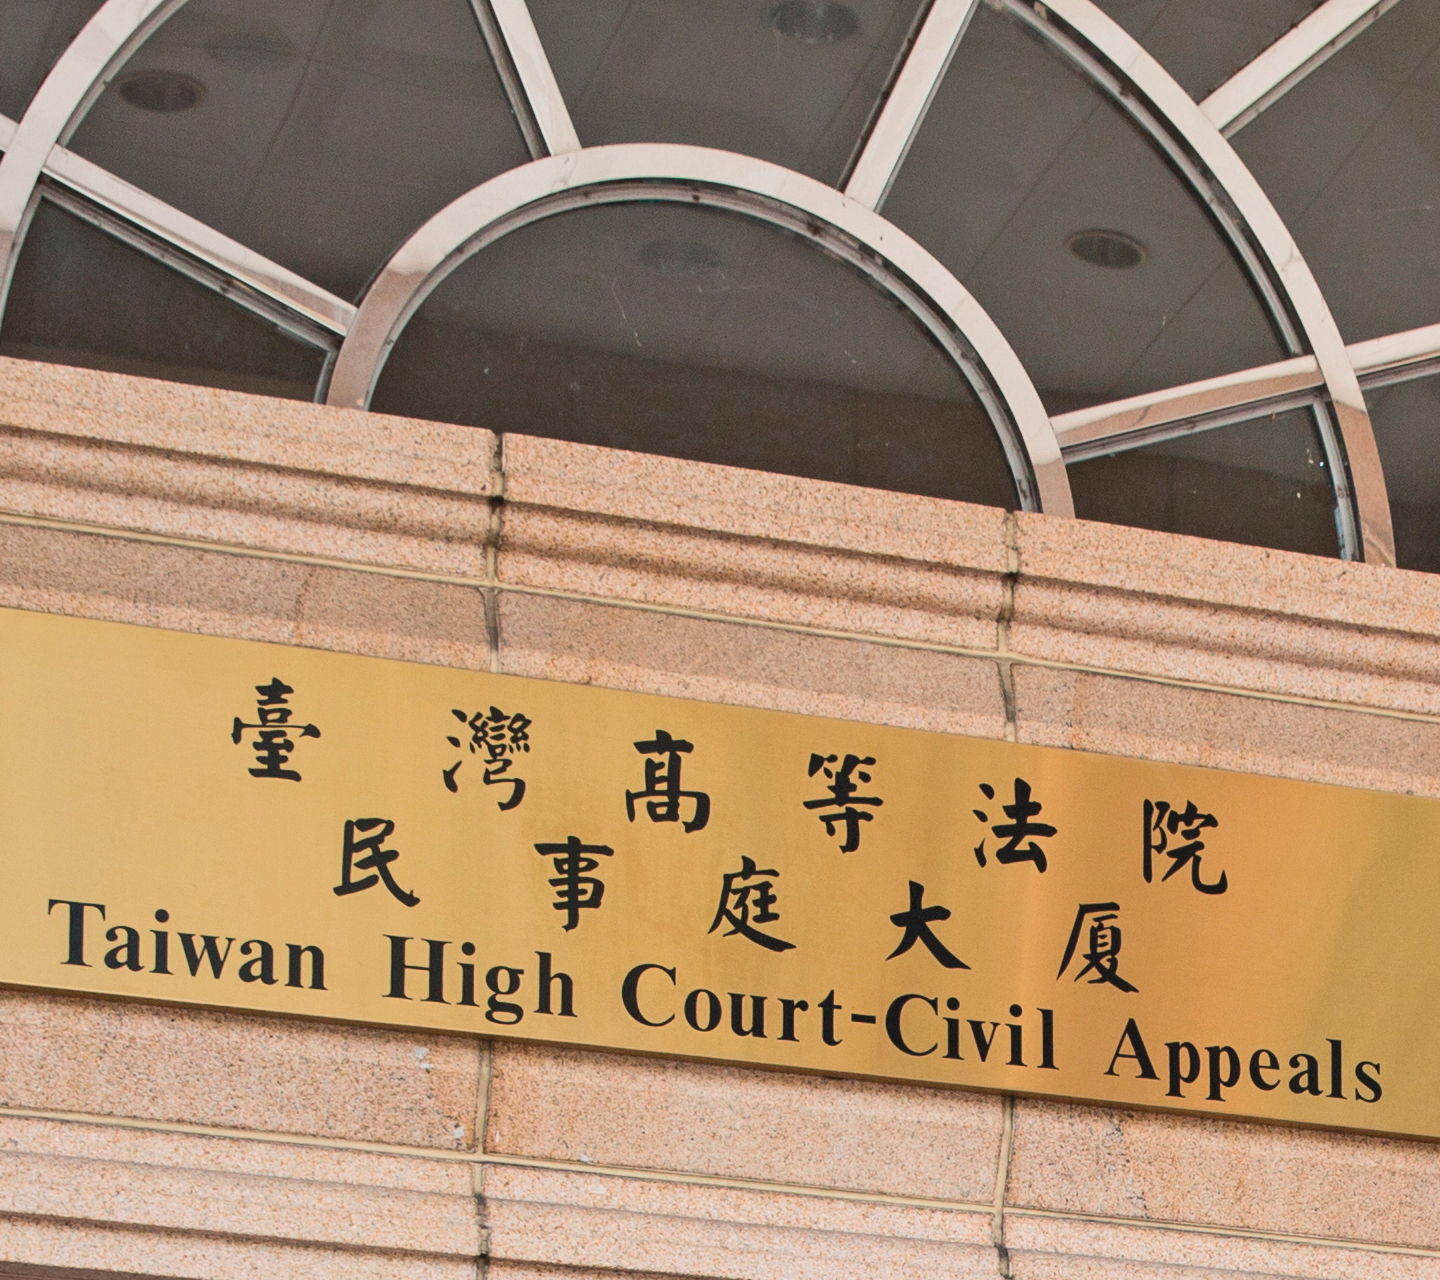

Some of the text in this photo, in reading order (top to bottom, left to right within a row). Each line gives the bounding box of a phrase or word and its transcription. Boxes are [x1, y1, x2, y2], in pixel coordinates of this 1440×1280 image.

[231, 677, 1228, 895] 臺灣高等法院
[46, 899, 1384, 1105] Taiwan High Court-Civil Appeals
